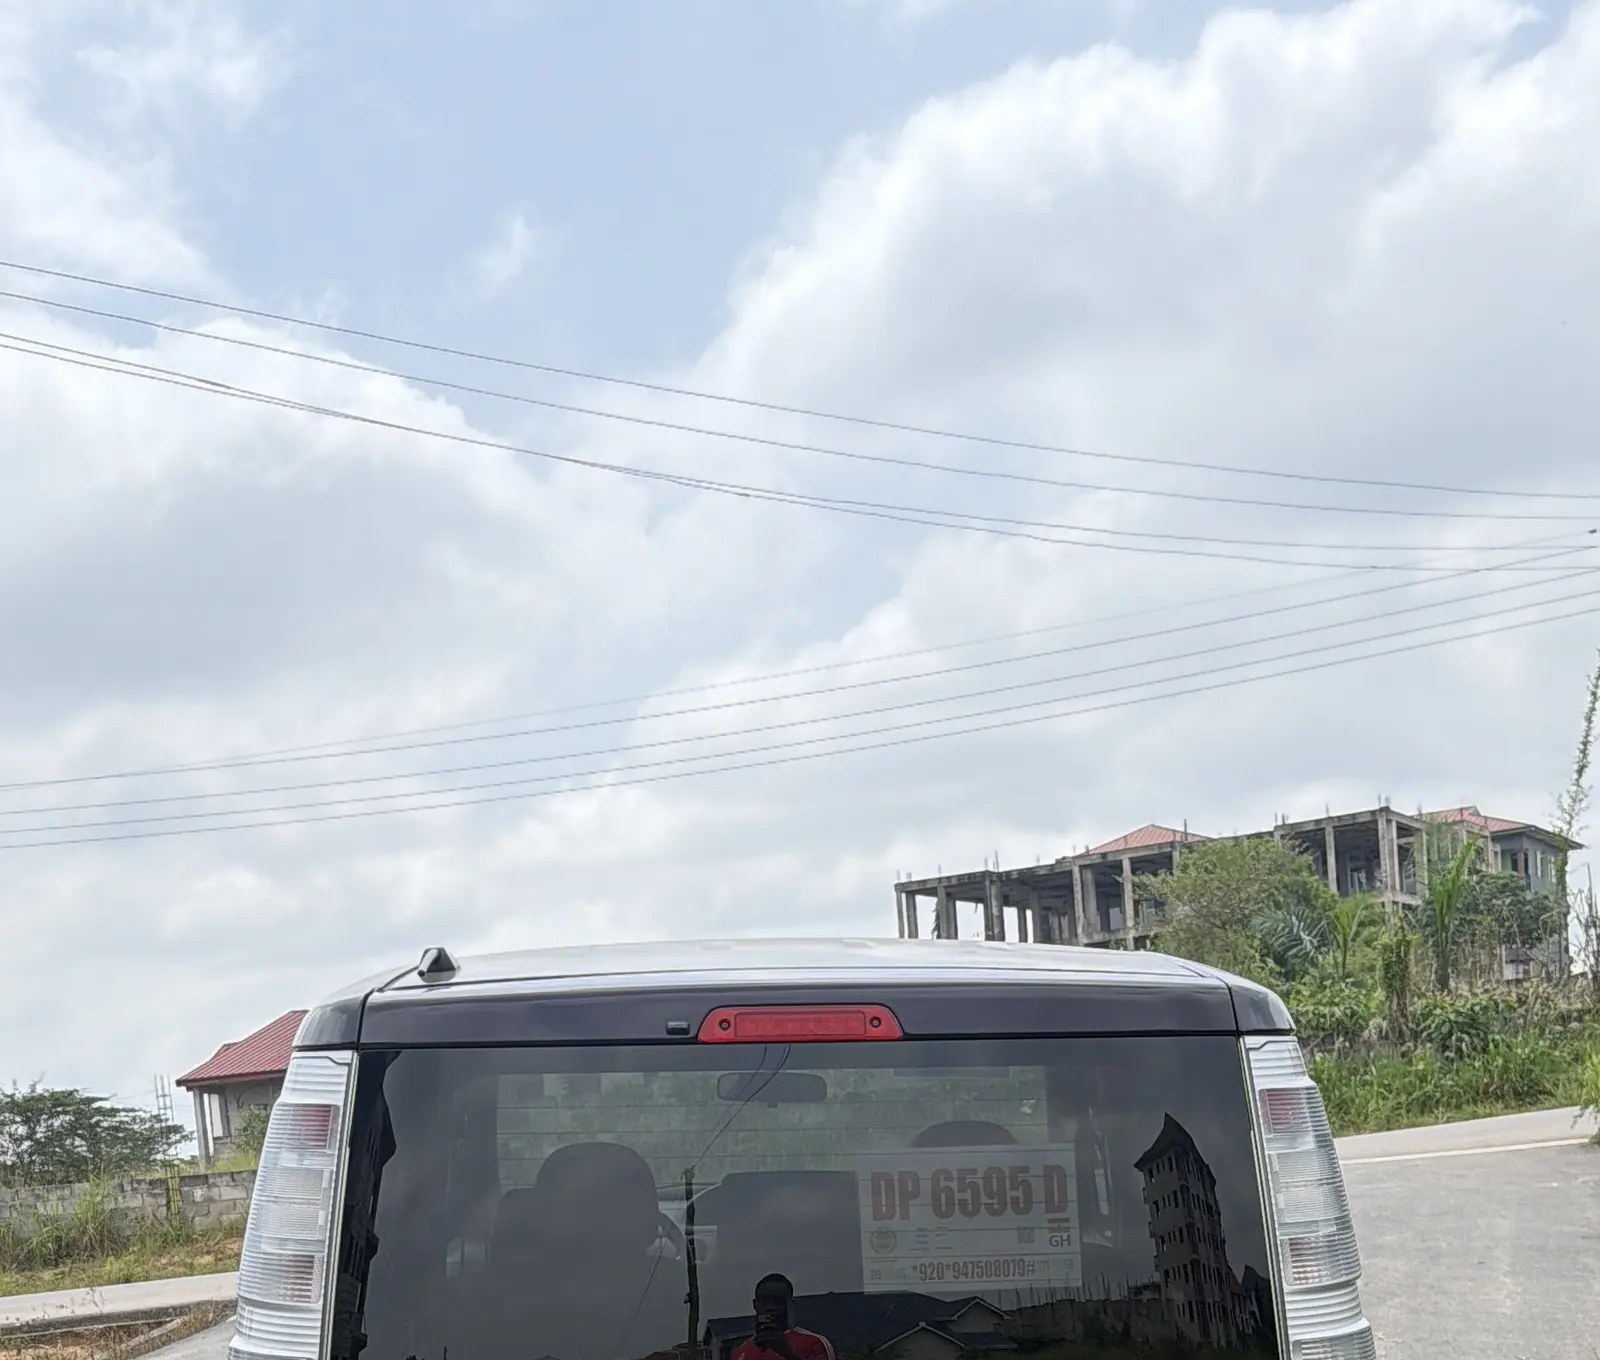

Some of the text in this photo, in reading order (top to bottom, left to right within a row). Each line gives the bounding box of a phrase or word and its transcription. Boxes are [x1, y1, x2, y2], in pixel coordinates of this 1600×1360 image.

[870, 1164, 1068, 1221] DP 6595 D
[1048, 1234, 1071, 1247] GH
